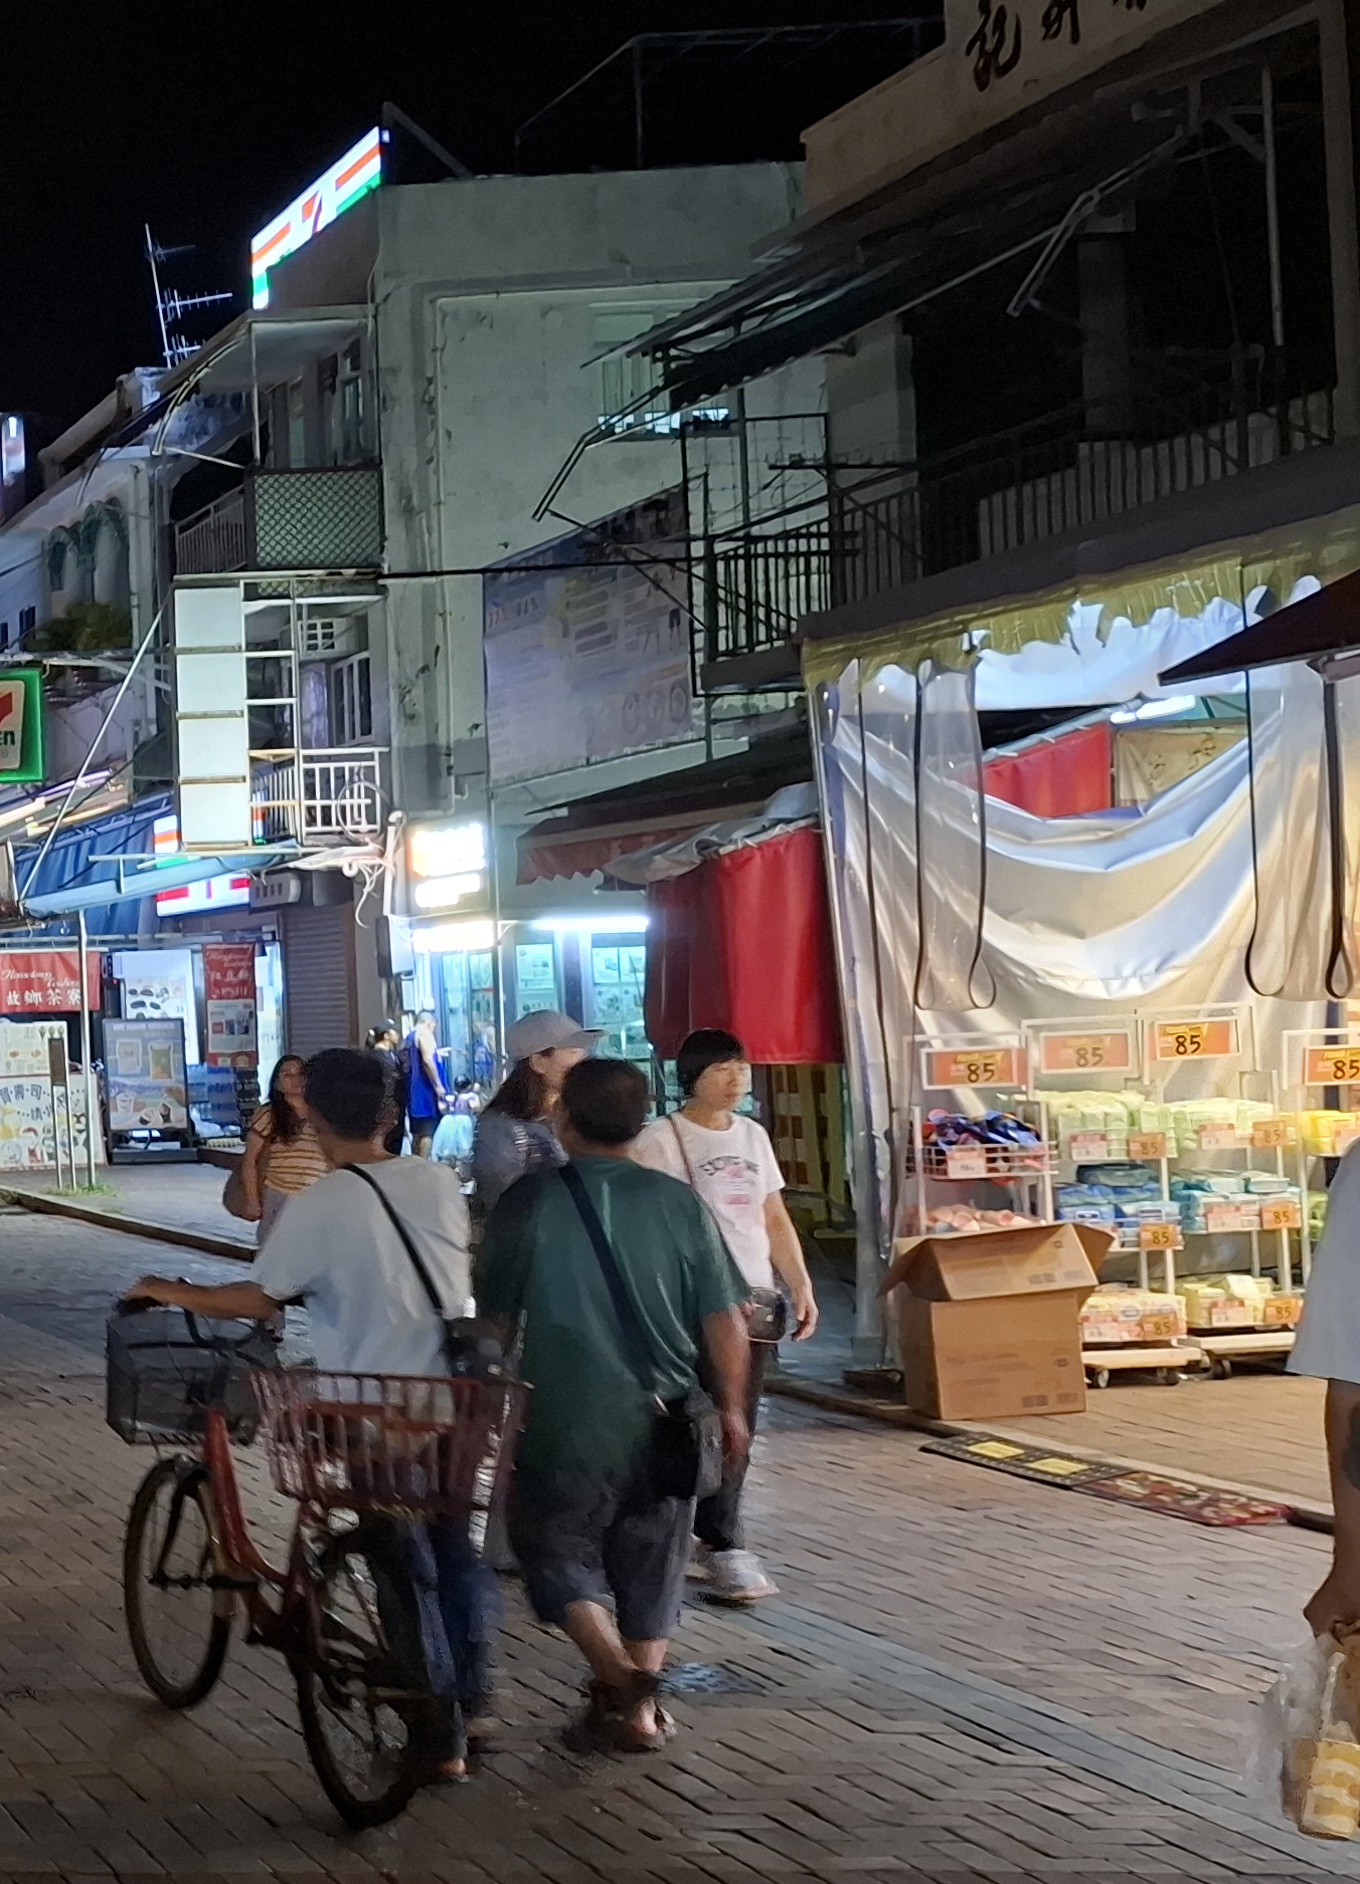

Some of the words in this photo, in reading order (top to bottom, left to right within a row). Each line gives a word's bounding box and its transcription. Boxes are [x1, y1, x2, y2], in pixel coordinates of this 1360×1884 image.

[1174, 1034, 1202, 1056] 85
[1074, 1046, 1104, 1068] 85
[966, 1062, 996, 1084] 85
[1332, 1058, 1360, 1081] 85
[1274, 1210, 1290, 1225] 85
[1151, 1230, 1170, 1245] 85
[1275, 1305, 1292, 1320] 85
